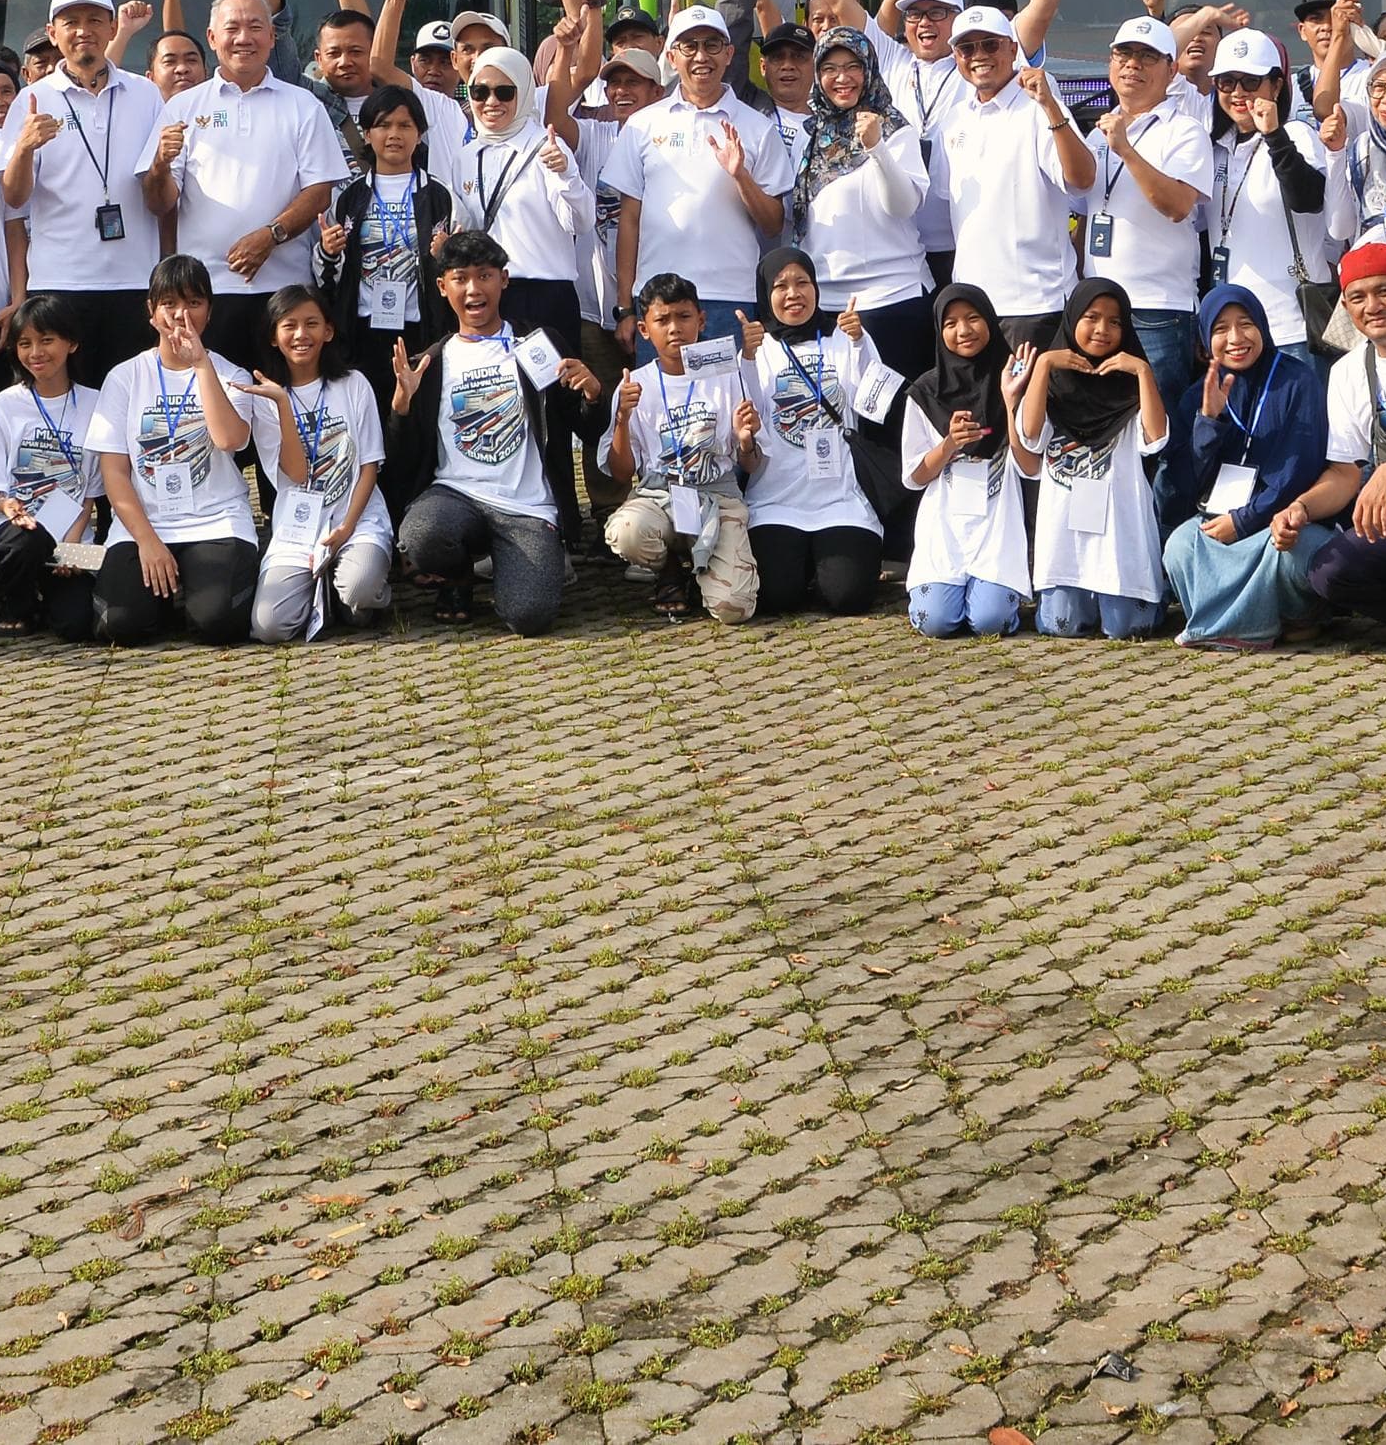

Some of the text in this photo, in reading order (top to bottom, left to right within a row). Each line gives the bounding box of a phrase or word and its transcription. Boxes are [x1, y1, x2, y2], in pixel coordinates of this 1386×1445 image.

[464, 366, 500, 382] MUDIK
[157, 395, 196, 405] MUDK
[36, 429, 73, 444] MUIK
